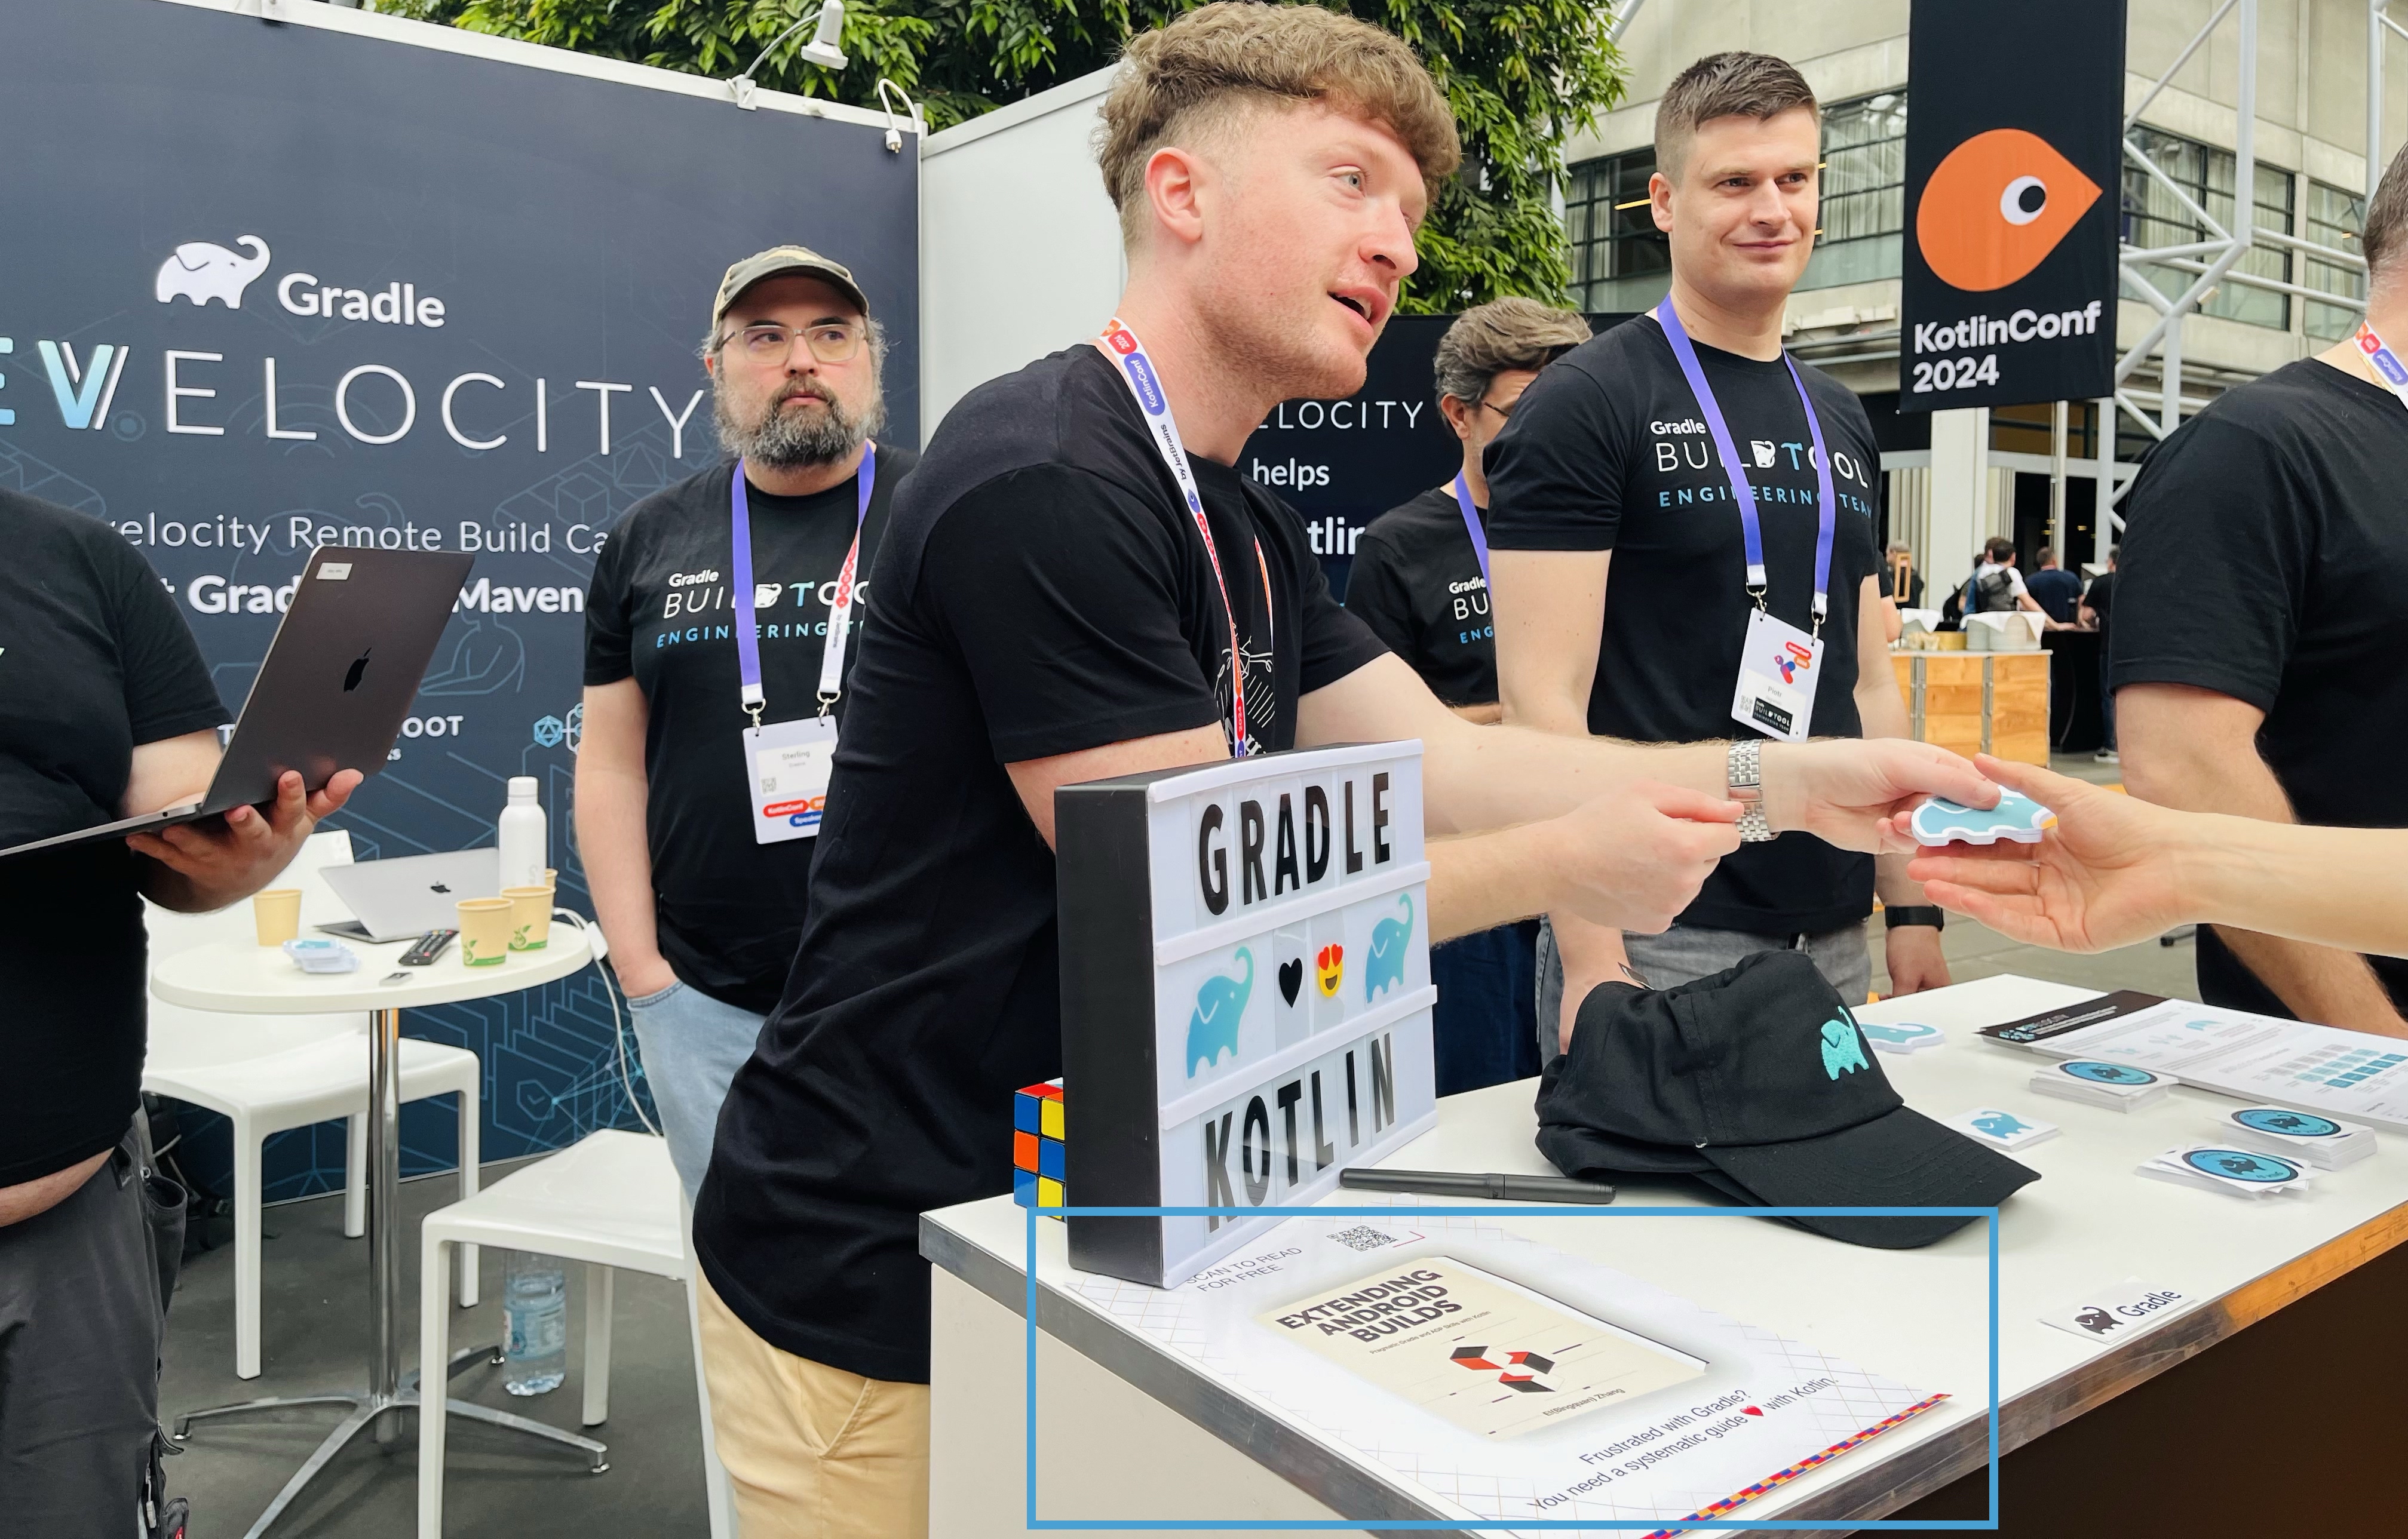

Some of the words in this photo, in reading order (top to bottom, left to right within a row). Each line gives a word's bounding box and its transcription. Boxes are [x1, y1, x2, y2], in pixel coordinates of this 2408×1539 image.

[278, 272, 446, 327] Gradle
[1914, 300, 2102, 354] KotlinConf
[1130, 359, 1158, 407] KotlinConf
[1912, 354, 2000, 394] 2024
[1258, 401, 1424, 429] LOCITY
[1650, 418, 1707, 435] Gradle
[1253, 457, 1330, 492] helps
[110, 512, 271, 555] elocity
[290, 517, 443, 552] Remote
[459, 521, 550, 553] Build
[566, 523, 608, 554] Ca
[188, 575, 302, 614] Grad
[452, 577, 584, 613] Maven
[668, 569, 719, 588] Gradle
[1449, 576, 1486, 594] Gradle
[1453, 592, 1489, 620] BU
[1459, 626, 1493, 644] ENG
[1199, 771, 1392, 916] GRADLE
[1205, 1031, 1396, 1233] KOTLIN
[1186, 1267, 1232, 1284] SCAN
[1229, 1260, 1256, 1270] TO
[1255, 1248, 1302, 1264] READ
[1196, 1278, 1237, 1292] FOR
[1235, 1264, 1284, 1281] FREE
[1275, 1270, 1444, 1329] EXTENDING
[1317, 1285, 1449, 1336] ANDROID
[2115, 1291, 2182, 1317] Gradle
[1348, 1299, 1463, 1343] BUILDS
[1593, 1388, 1626, 1400] Zhang
[1526, 1493, 1569, 1510] You
[1566, 1472, 1613, 1496] need
[1611, 1467, 1628, 1477] a
[1624, 1433, 1707, 1470] systematic
[1704, 1414, 1749, 1439] guide
[1762, 1394, 1798, 1411] with
[1789, 1377, 1839, 1398] Kotlin.
[1579, 1426, 1665, 1465] Frustrated
[1660, 1414, 1697, 1432] with
[1691, 1389, 1751, 1418] Gradle?
